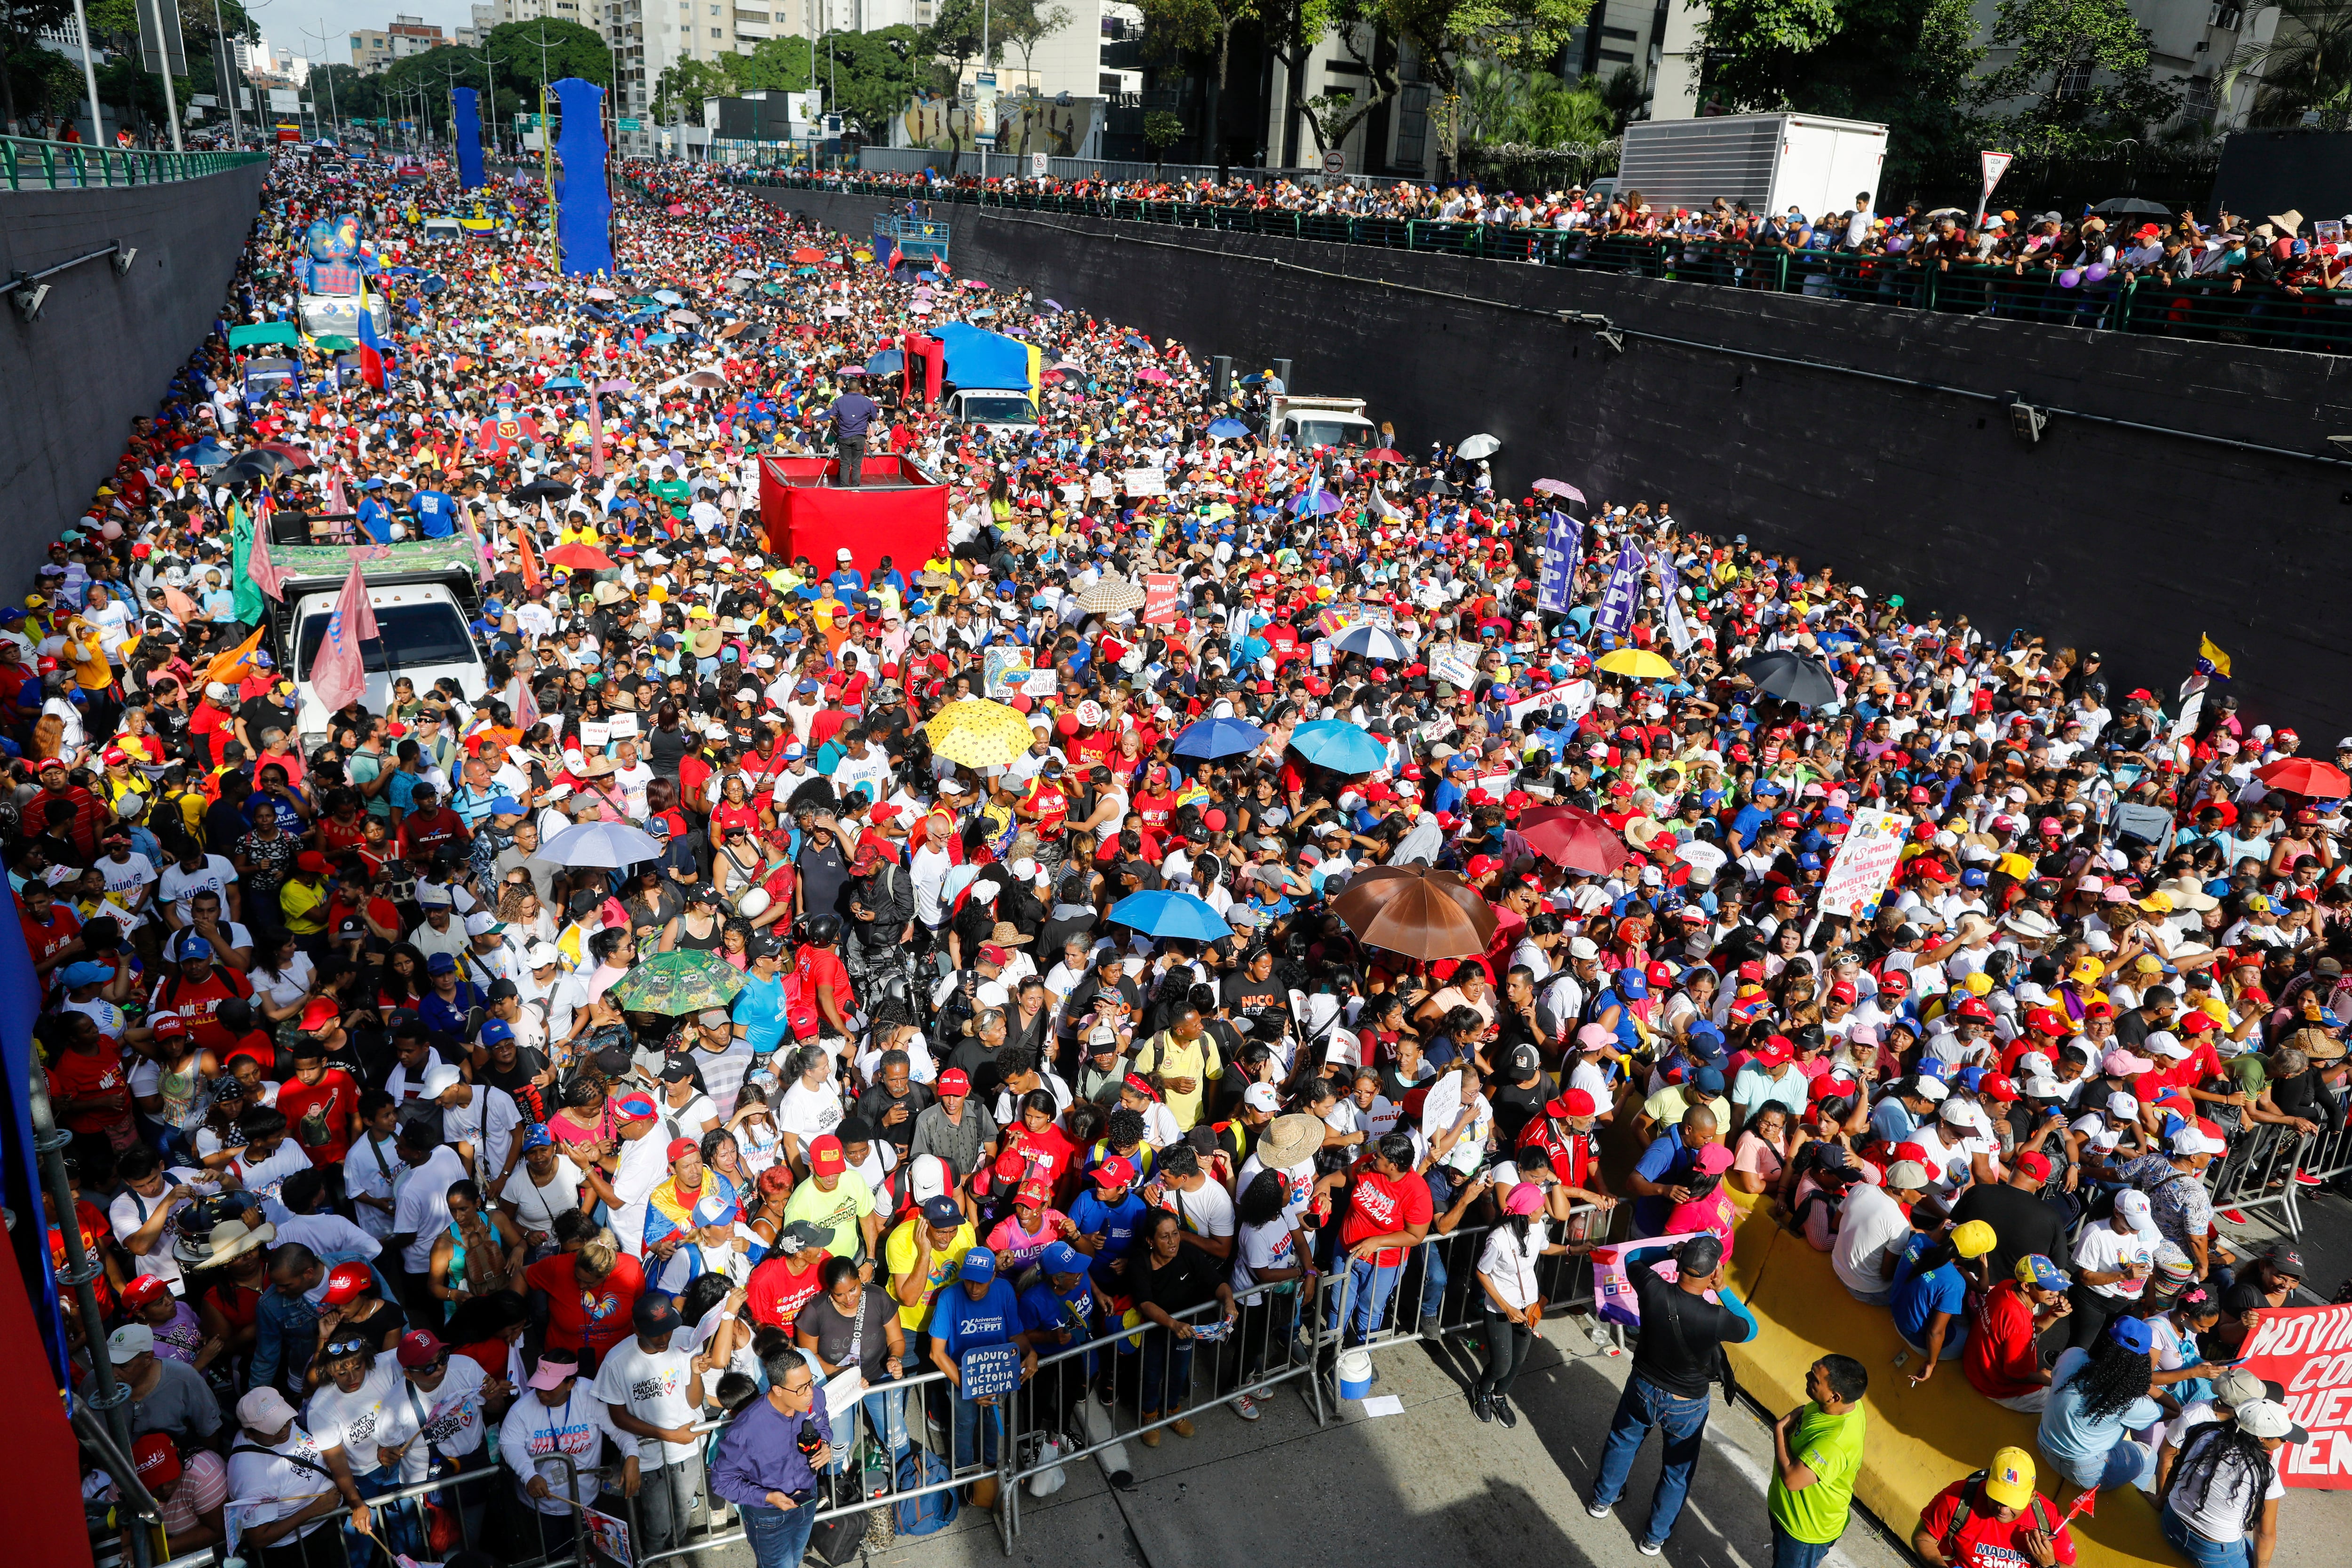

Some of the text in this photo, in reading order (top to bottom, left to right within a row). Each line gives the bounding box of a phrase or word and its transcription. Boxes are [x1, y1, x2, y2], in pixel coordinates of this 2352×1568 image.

[330, 269, 347, 278] VOY
[326, 277, 355, 286] GALLO
[1150, 581, 1176, 592] PSUV
[1147, 597, 1174, 613] Con Maduro
[1147, 606, 1173, 620] somos más
[1440, 662, 1465, 678] CAÑICITO
[1030, 678, 1057, 694] NICOLÁS
[1539, 691, 1562, 708] AVV
[1859, 855, 1902, 873] BOLIVAR
[1829, 870, 1884, 895] MANGUITO
[1843, 889, 1877, 907] Presente
[188, 941, 196, 951] LA
[652, 975, 667, 984] 10
[681, 974, 698, 984] 10
[1241, 994, 1274, 1008] NICO
[819, 1110, 838, 1125] MADURO
[1372, 1110, 1400, 1123] PSUV
[1364, 1180, 1396, 1206] SIGAMOS
[858, 1290, 866, 1331] NEWFASHION
[1074, 1293, 1090, 1313] 28
[961, 1319, 977, 1335] 26
[415, 1333, 430, 1347] B
[852, 1332, 861, 1344] 80
[979, 1363, 1000, 1374] PPT
[633, 1377, 655, 1389] CHÁVEZ
[967, 1370, 1013, 1386] VICTORIA
[633, 1383, 663, 1397] MADURO
[640, 1391, 664, 1401] SIEMPRE
[347, 1414, 371, 1433] CHÁVEZ
[349, 1417, 378, 1441] MADUR
[1975, 1542, 2032, 1564] MADURO
